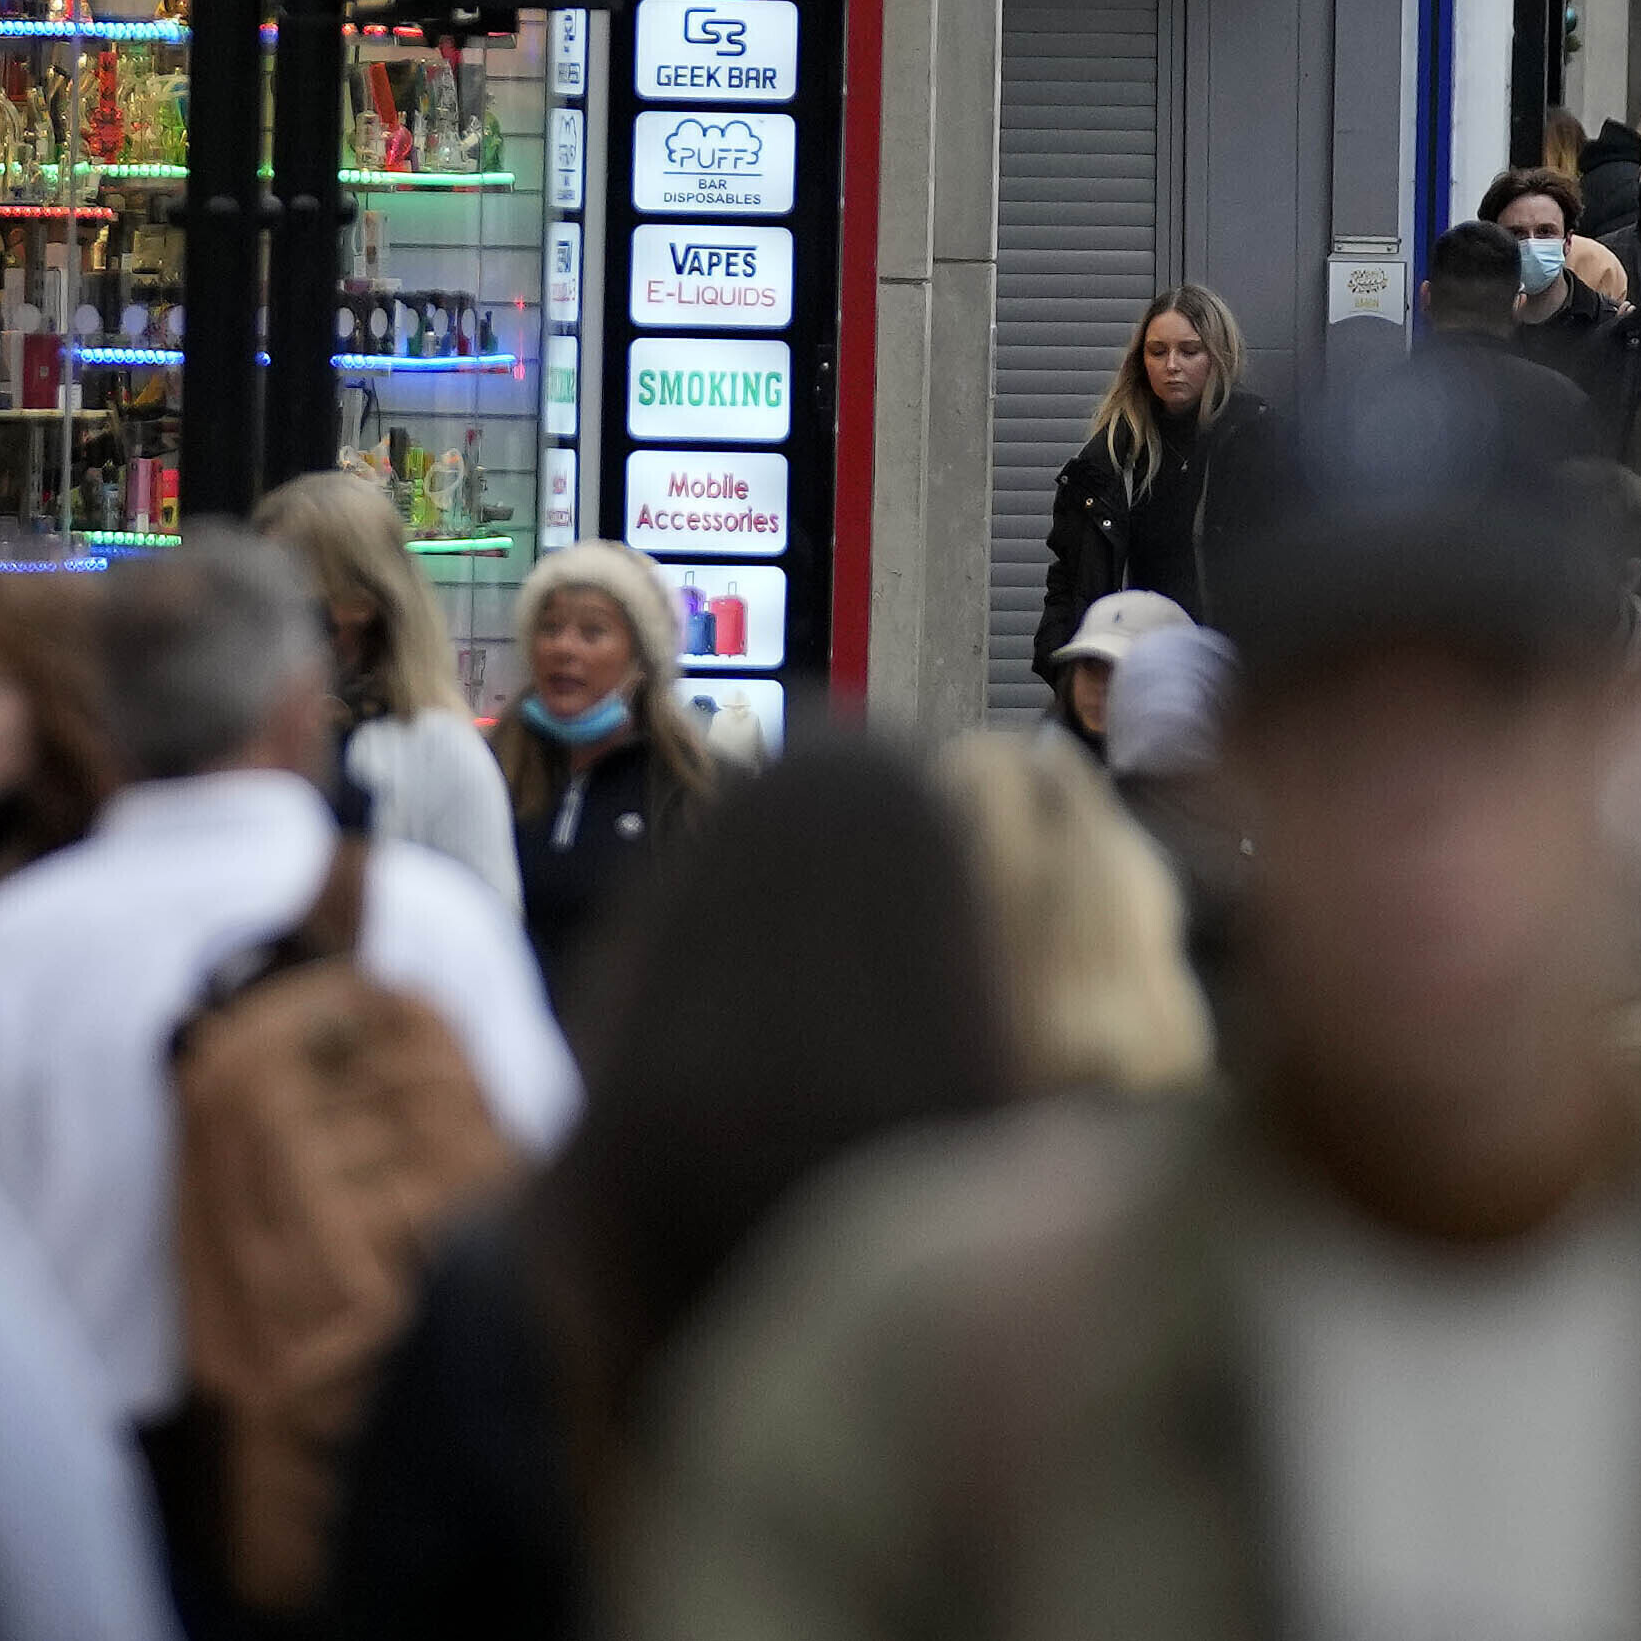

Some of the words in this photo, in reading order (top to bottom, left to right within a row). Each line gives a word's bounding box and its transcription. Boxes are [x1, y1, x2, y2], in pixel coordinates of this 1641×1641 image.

[656, 65, 722, 88] GEEK
[728, 66, 777, 89] BAR
[679, 147, 749, 170] PUFF
[698, 178, 727, 190] BAR
[663, 192, 761, 205] DISPOSABLES
[669, 243, 758, 277] VAPES
[638, 369, 783, 408] SMOKING
[668, 471, 750, 500] Mobile
[636, 503, 780, 534] Accessories
